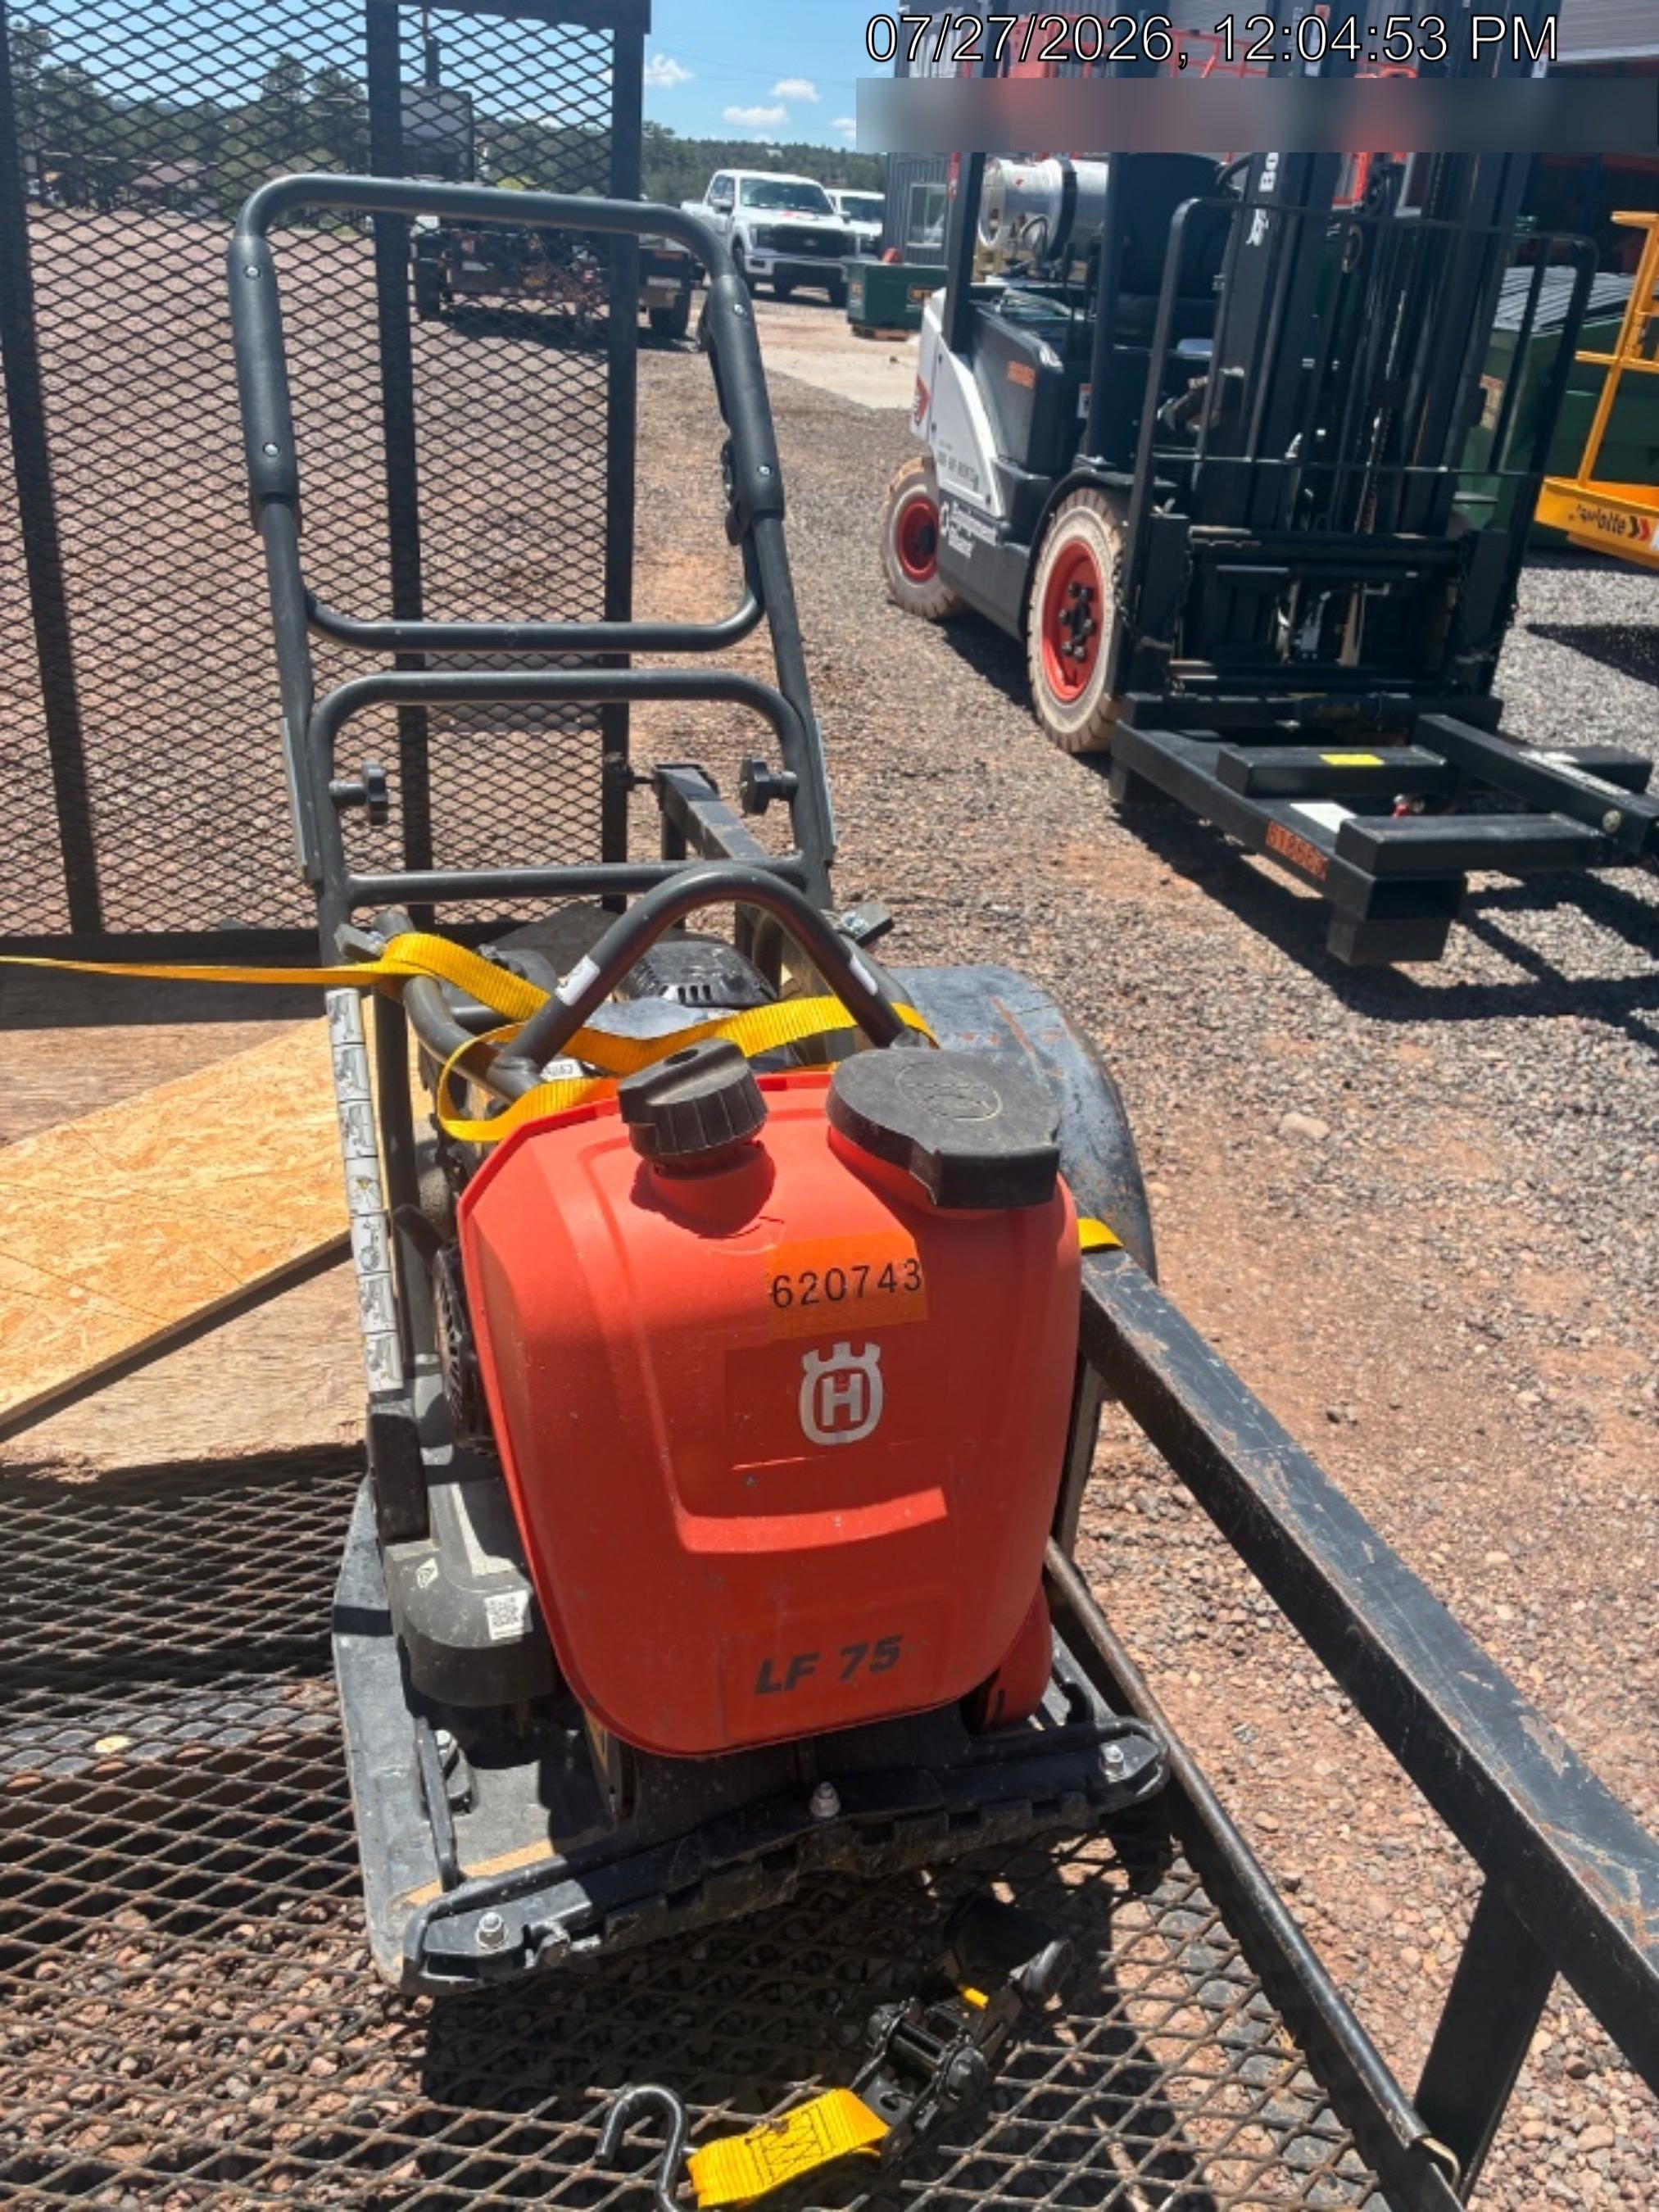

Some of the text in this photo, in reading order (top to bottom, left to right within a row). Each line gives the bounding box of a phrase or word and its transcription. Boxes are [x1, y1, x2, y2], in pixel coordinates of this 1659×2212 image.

[772, 1258, 922, 1308] 620743
[755, 1634, 904, 1695] LF 75
